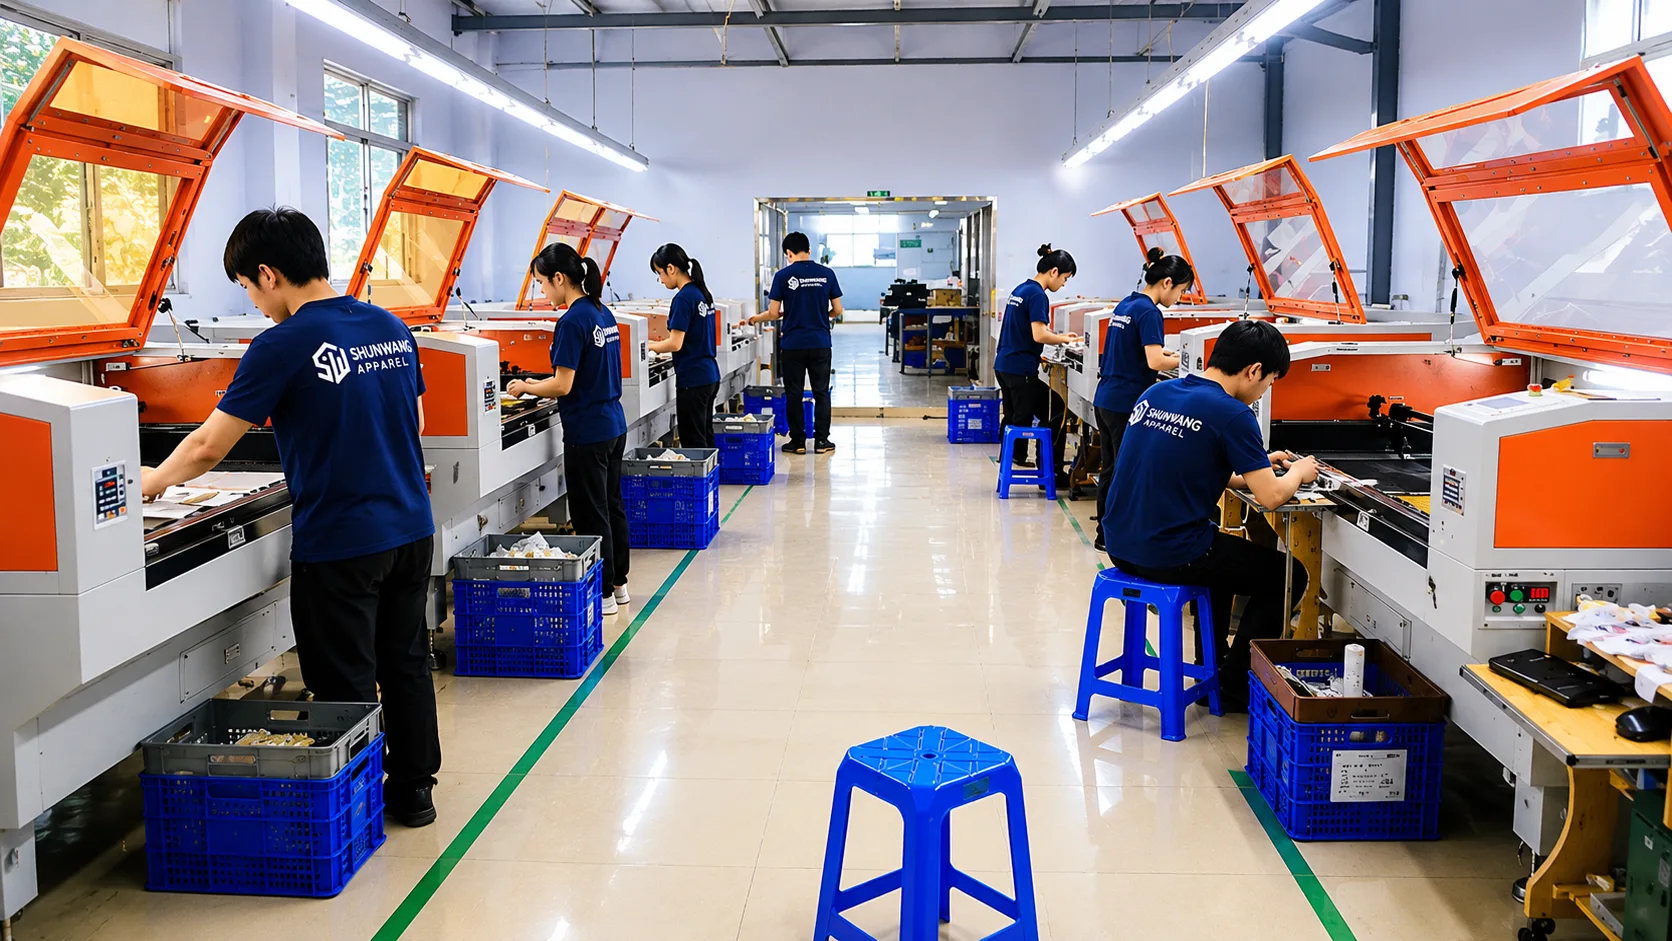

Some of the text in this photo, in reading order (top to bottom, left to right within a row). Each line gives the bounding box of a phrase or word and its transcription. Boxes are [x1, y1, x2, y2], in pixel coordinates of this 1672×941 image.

[350, 340, 413, 361] SHUNWANG
[357, 357, 409, 375] APPAREL
[1143, 419, 1184, 439] APPAREL
[1146, 408, 1203, 432] SHUNWANG
